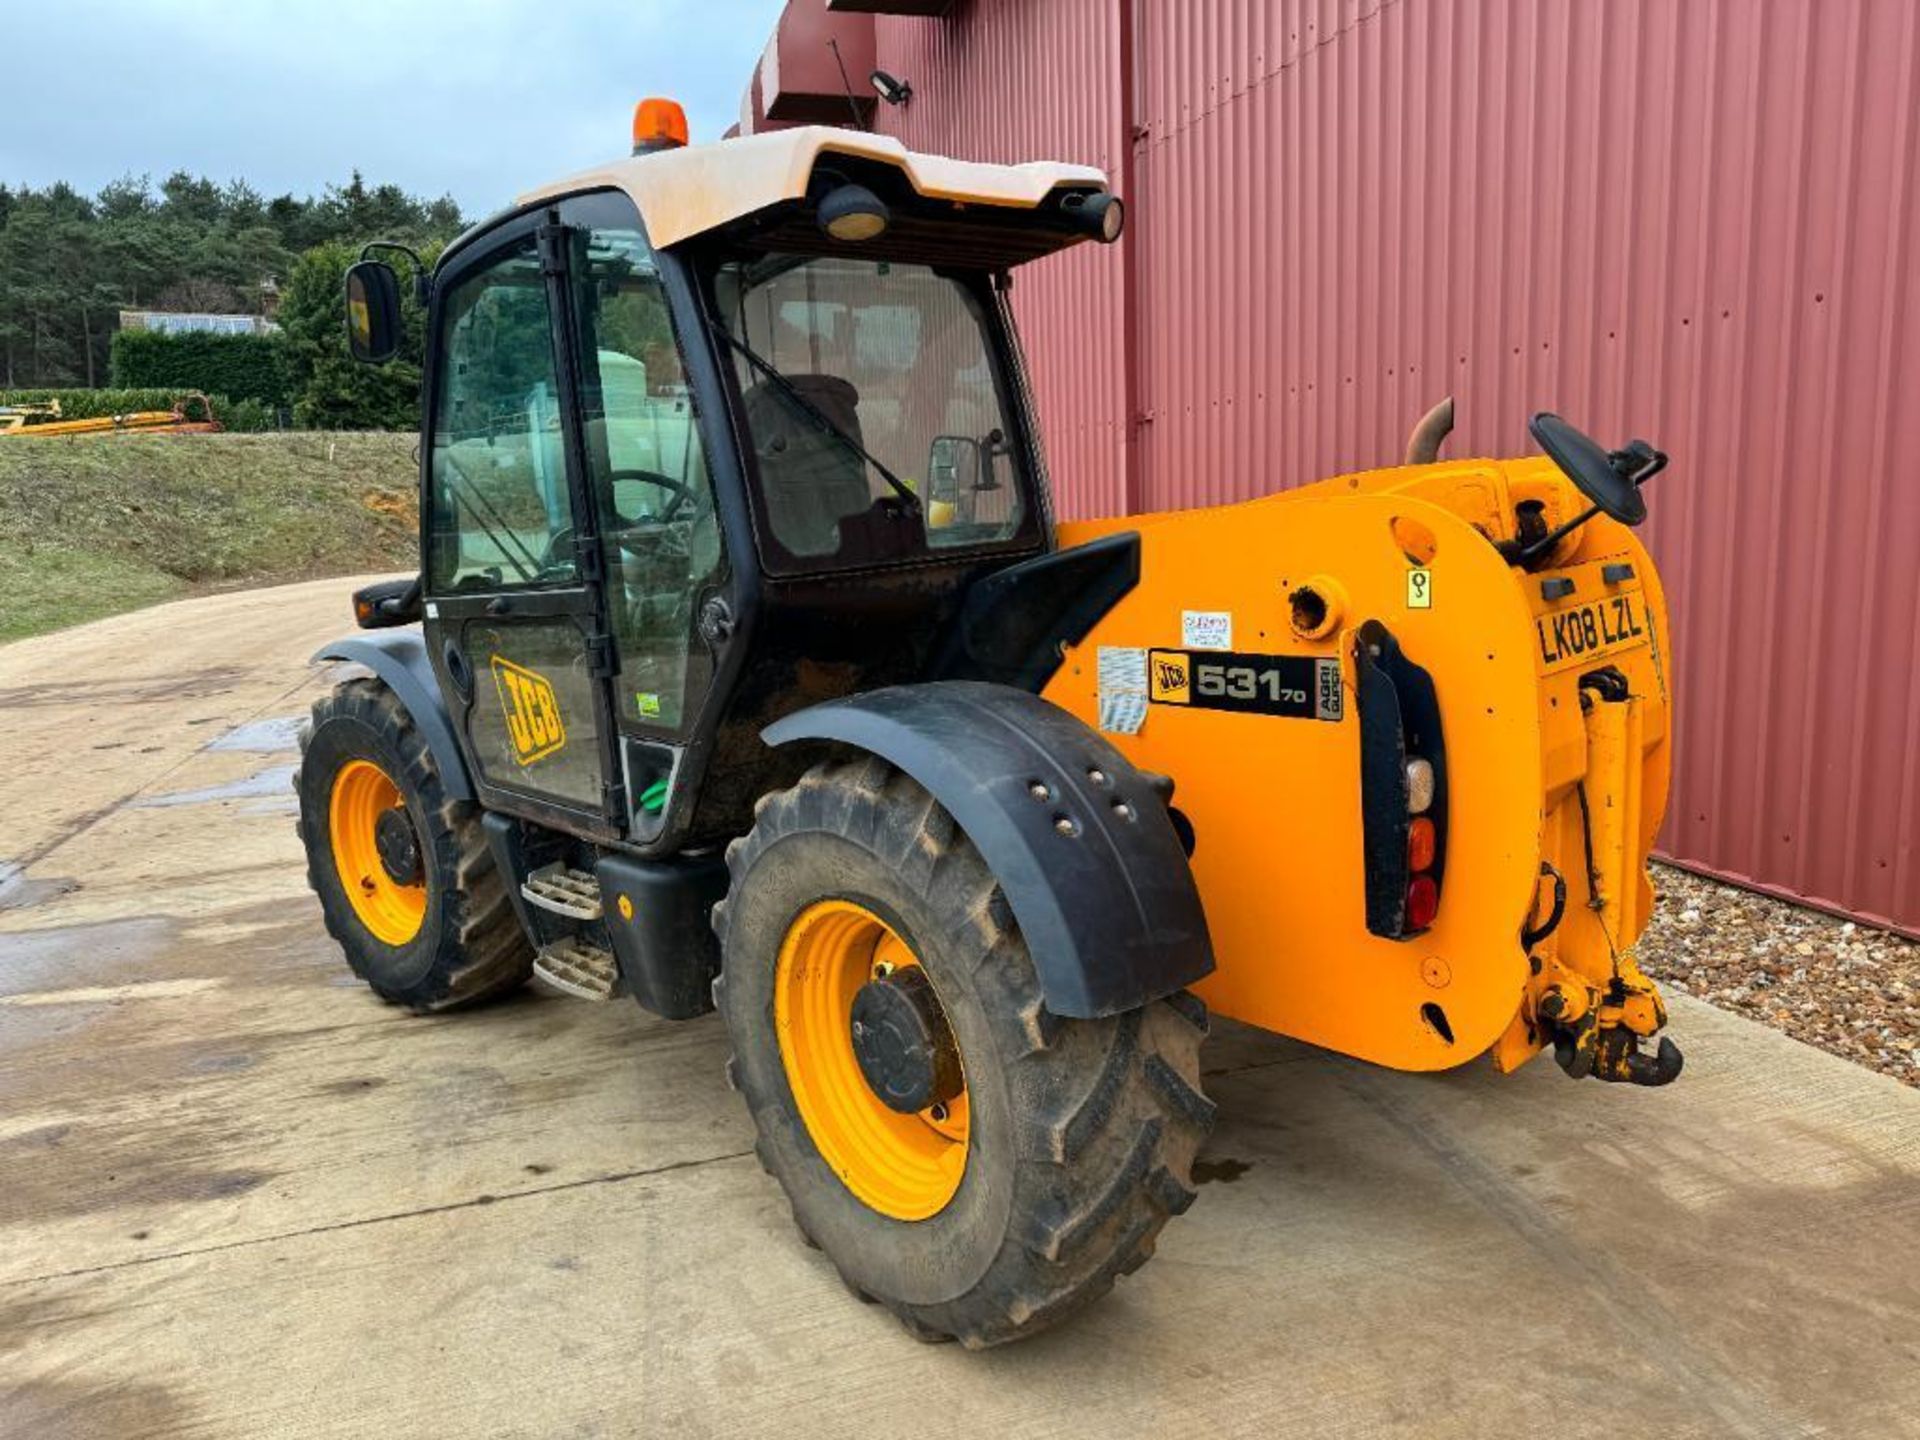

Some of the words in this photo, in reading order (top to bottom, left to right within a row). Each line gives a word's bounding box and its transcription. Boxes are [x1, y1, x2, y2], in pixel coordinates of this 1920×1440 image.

[1537, 608, 1598, 663] LK08
[1598, 597, 1642, 644] LZL
[1159, 663, 1188, 690] JCB
[1196, 664, 1280, 702] 531
[1280, 688, 1307, 704] 70
[1320, 665, 1331, 712] AGRI
[503, 670, 560, 754] JCB
